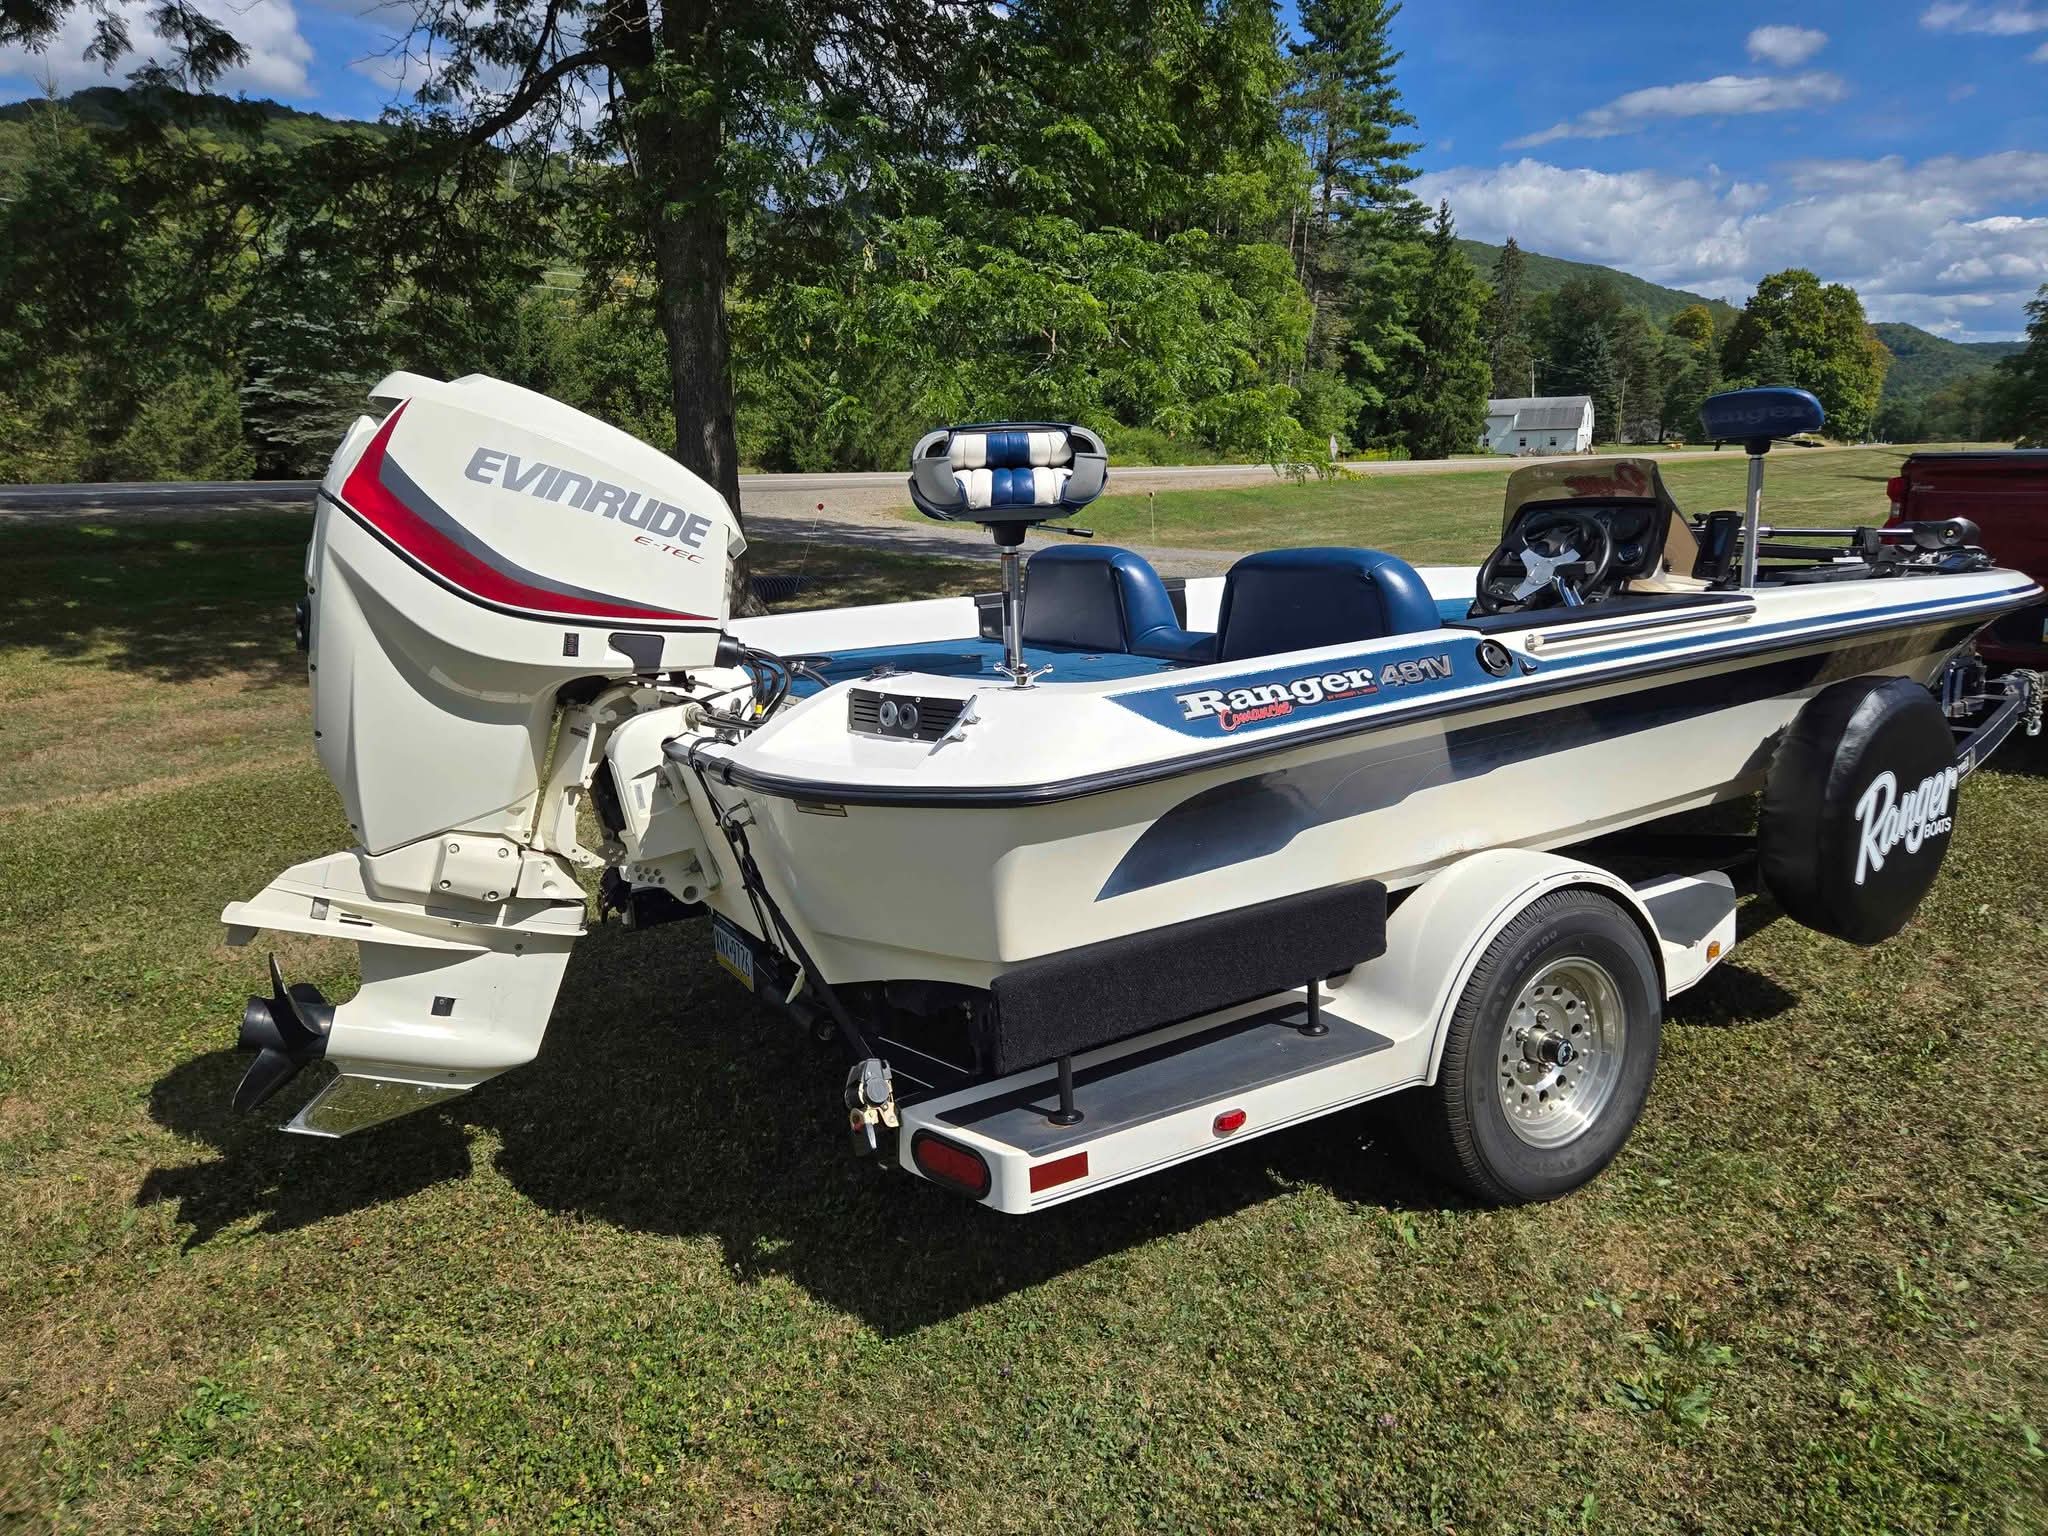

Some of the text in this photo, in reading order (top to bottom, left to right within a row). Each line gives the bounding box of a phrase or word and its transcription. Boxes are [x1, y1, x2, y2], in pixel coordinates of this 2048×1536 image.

[465, 447, 713, 548] EVINRUDE
[634, 535, 705, 565] E-TEC
[1177, 655, 1453, 719] Ranger 481V
[1220, 699, 1294, 731] Comanche
[1855, 766, 1958, 885] Ranger
[1923, 816, 1952, 839] BOATS
